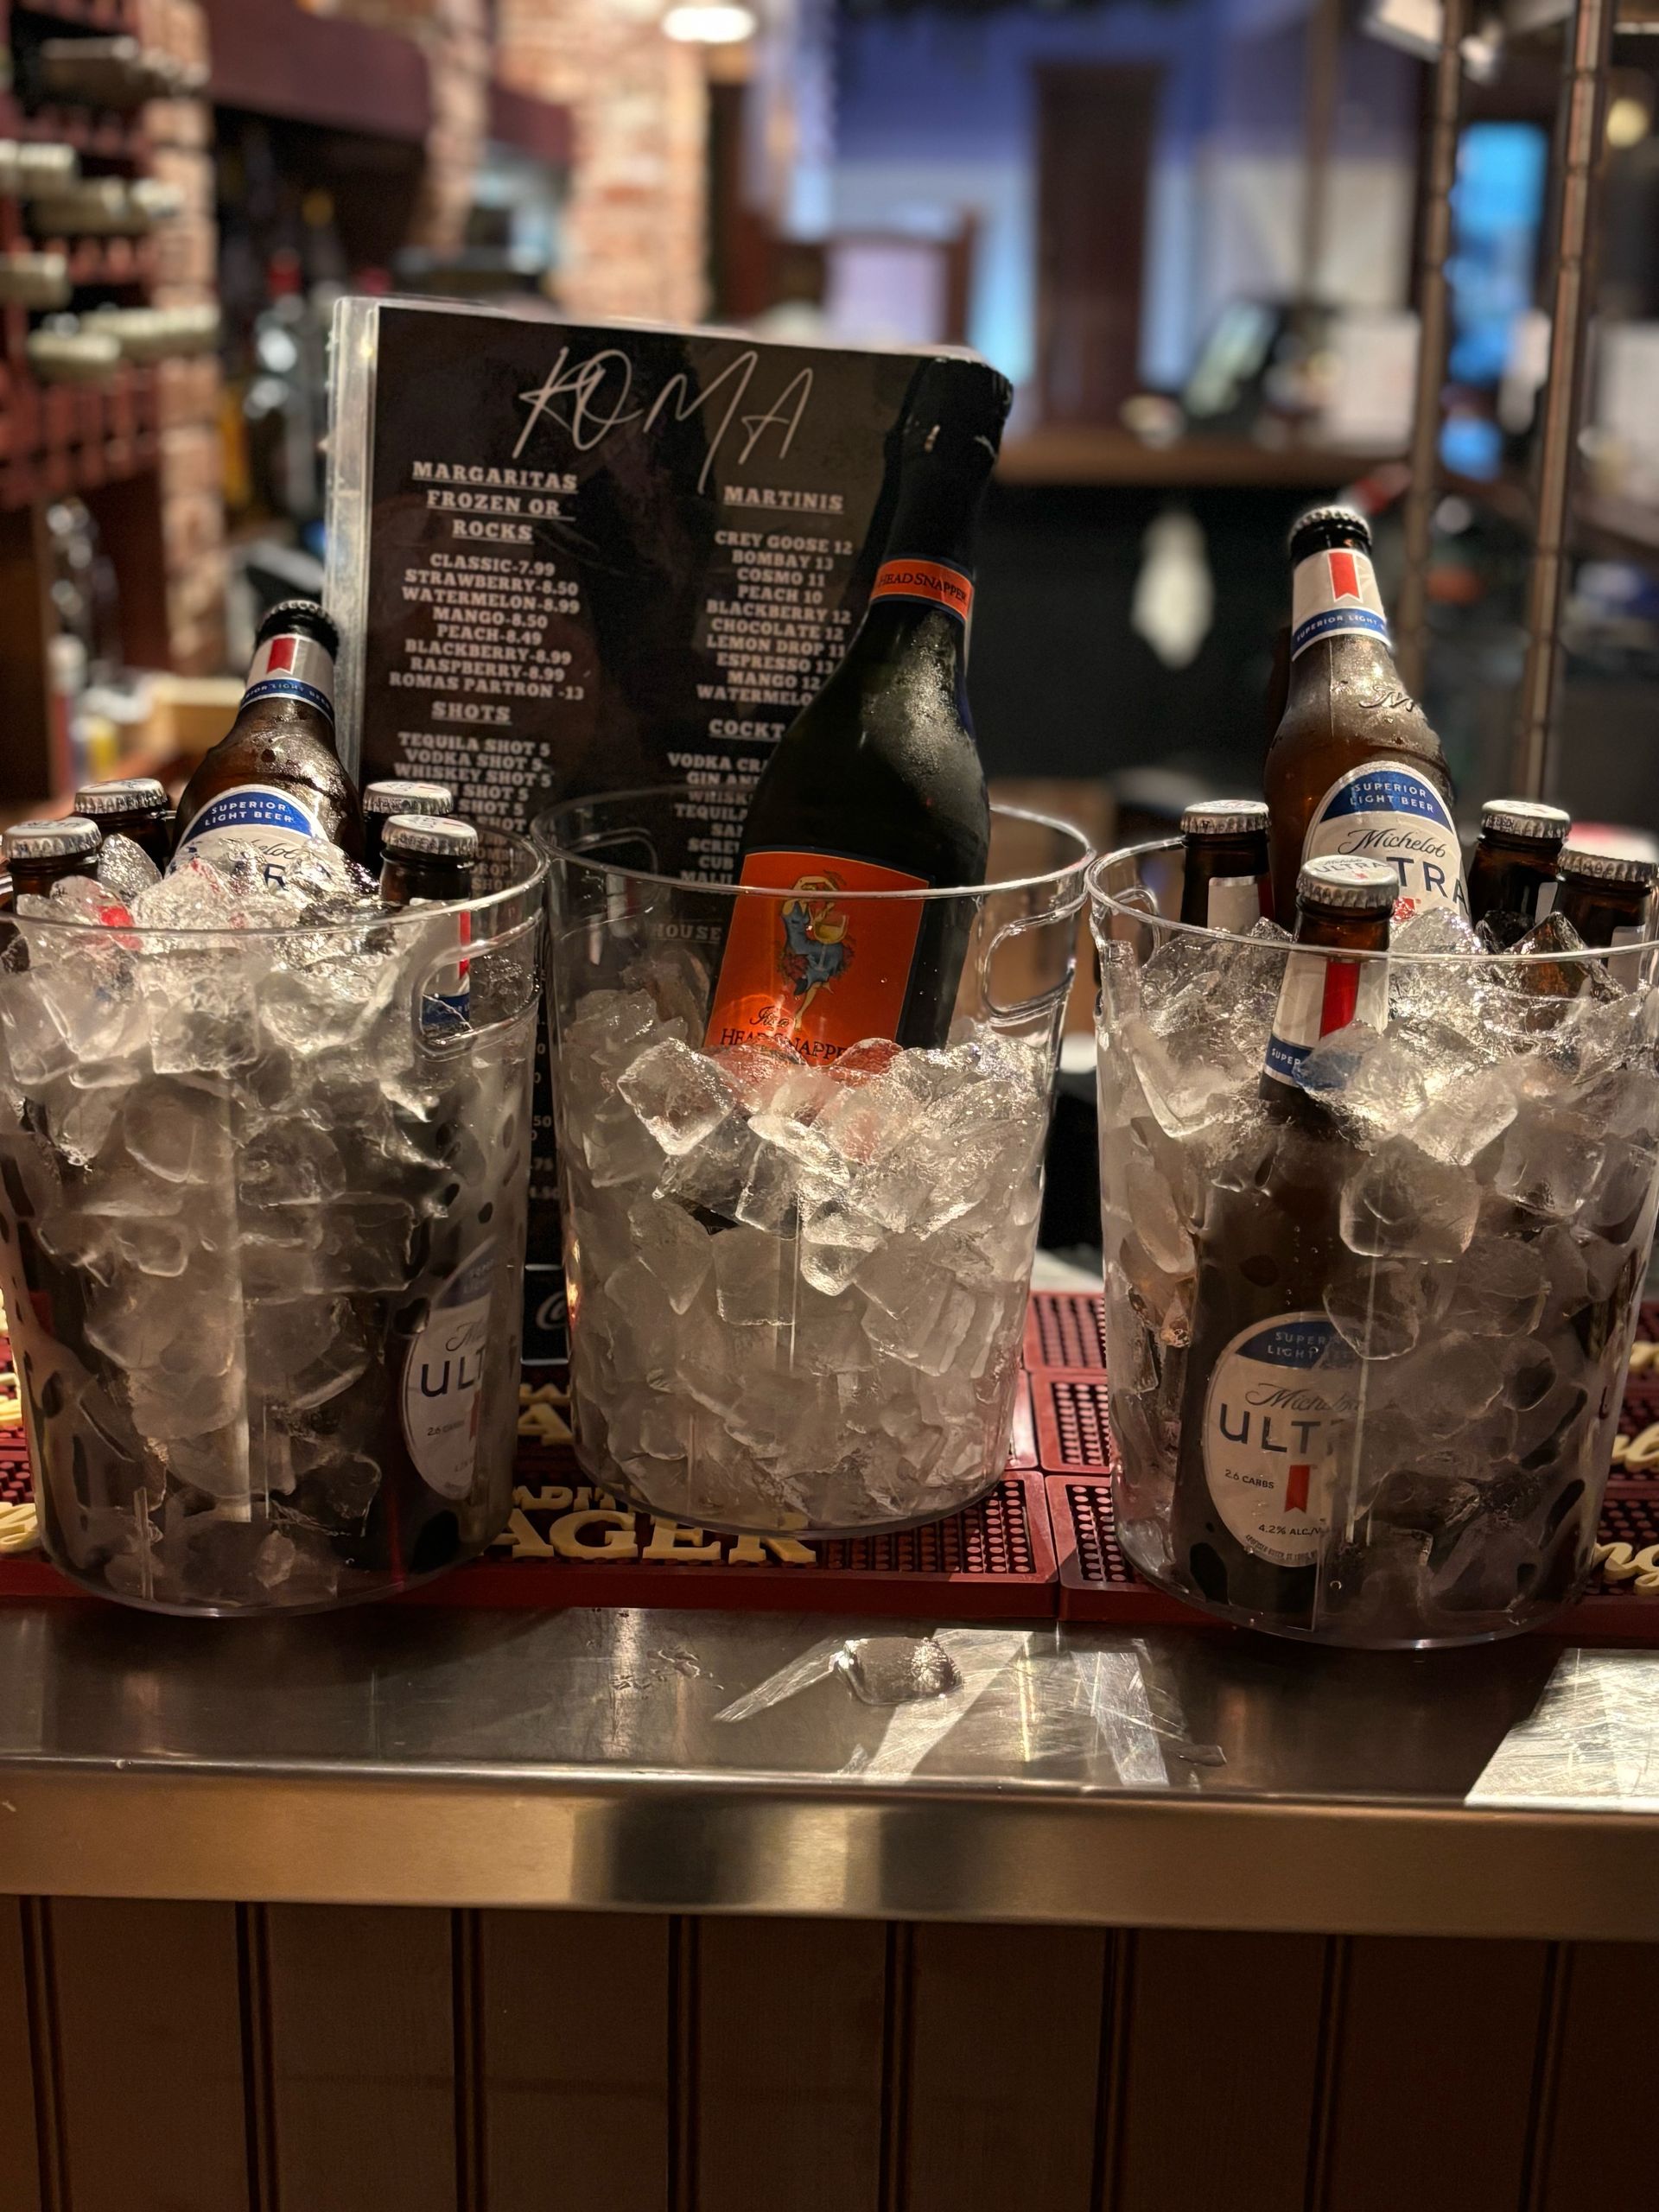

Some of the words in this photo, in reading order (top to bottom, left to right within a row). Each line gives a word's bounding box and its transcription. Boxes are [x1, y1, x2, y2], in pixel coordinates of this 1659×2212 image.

[413, 461, 577, 491] MARGARITAS
[427, 489, 521, 512] FROZEN
[528, 498, 560, 516] OR
[724, 486, 843, 511] MARTINIS
[453, 519, 532, 541] ROCKS
[767, 536, 829, 553] GOOSE
[834, 540, 852, 555] 12
[429, 553, 555, 577] CLASSIC-7.99
[732, 550, 810, 569] BOMBAY
[404, 569, 578, 596] STRAWBERRY-8.50
[737, 568, 804, 587] COSMO
[402, 587, 580, 613] WATERMELON-8.99
[738, 584, 798, 603] PEACH
[804, 590, 823, 605] 10
[433, 607, 548, 629] MANGO-8.50
[706, 599, 828, 622] BLACKBERRY
[711, 617, 819, 639] CHOCOLATE
[1296, 614, 1344, 641] SUPERIOR
[405, 639, 572, 664] BLACKBERRY-8.99
[706, 634, 771, 652] LEMON
[777, 639, 825, 657] DROP
[716, 652, 810, 673] ESPRESSO
[389, 672, 460, 690] ROMAS
[463, 677, 553, 698] PARTRON
[727, 671, 798, 690] MANGO
[696, 683, 812, 707] WATERMELO
[432, 701, 511, 722] SHOTS
[709, 718, 785, 739] COCKT
[397, 731, 479, 752] TEQUILA
[484, 738, 536, 756] SHOT
[405, 748, 472, 766] VODKA
[476, 753, 527, 771] SHOT
[667, 752, 732, 772] VODKA
[394, 763, 480, 782] WHISKEY
[486, 769, 537, 787] SHOT
[462, 784, 515, 800] SHOT
[1354, 782, 1427, 798] SUPERIOR
[211, 801, 287, 814] SUPERIOR
[458, 798, 509, 816] SHOT
[1350, 794, 1394, 805] LIGHT
[1401, 796, 1433, 813] BEER
[205, 810, 247, 826] LIGHT
[254, 810, 295, 823] BEER
[1338, 828, 1446, 858] Michelob
[698, 855, 734, 871] CUB
[1386, 856, 1470, 916] TRA
[1271, 1047, 1300, 1066] SUPER
[1219, 1402, 1321, 1454] ULT
[1225, 1469, 1240, 1481] 2.6
[1242, 1475, 1274, 1490] CARBS
[485, 1508, 817, 1565] AGER
[1258, 1523, 1286, 1535] 4.2%
